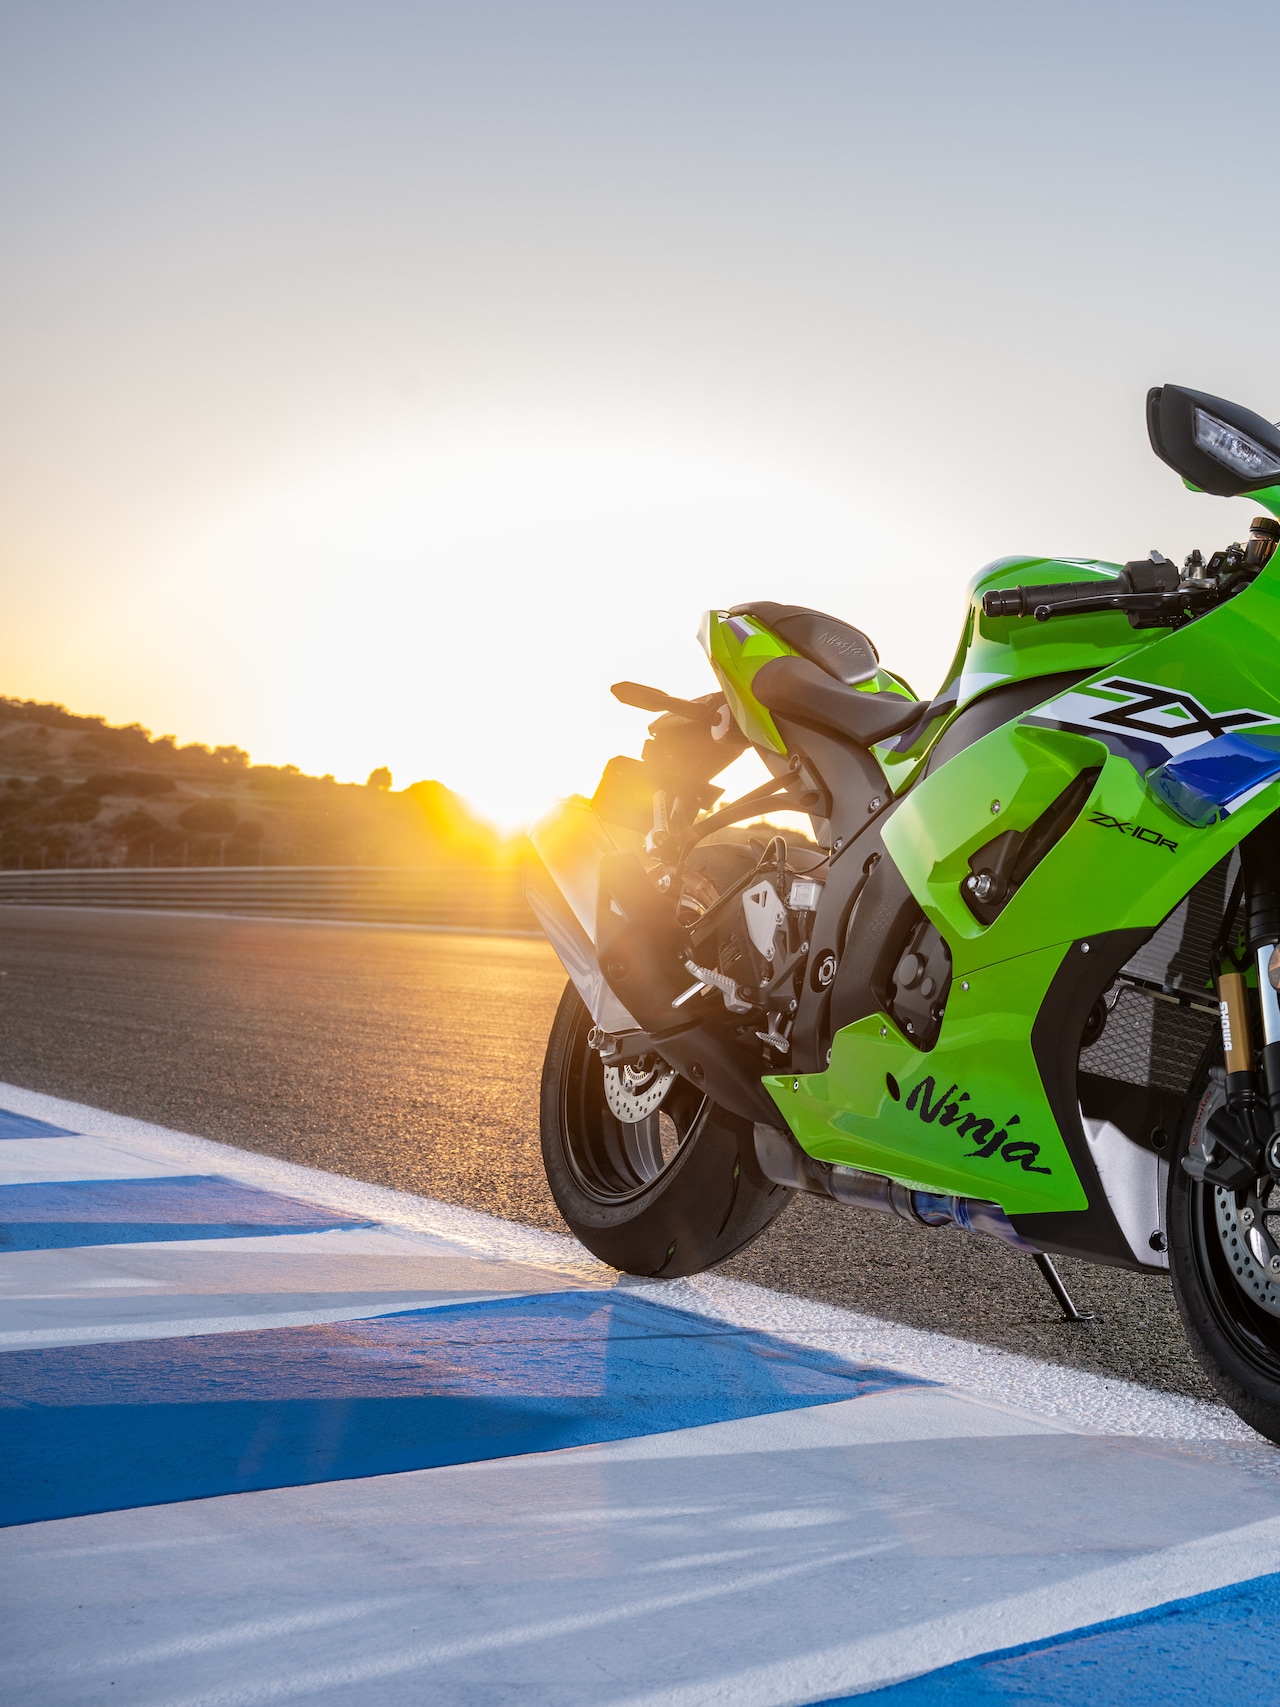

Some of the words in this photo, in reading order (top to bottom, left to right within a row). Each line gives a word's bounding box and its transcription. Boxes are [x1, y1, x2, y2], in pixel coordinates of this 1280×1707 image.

[818, 632, 867, 657] Ninja
[1088, 679, 1273, 739] ZX
[1087, 811, 1179, 854] ZX-10R
[1219, 1001, 1233, 1051] SHOWA
[906, 1075, 1052, 1175] Ninja
[1191, 1090, 1212, 1146] brembo
